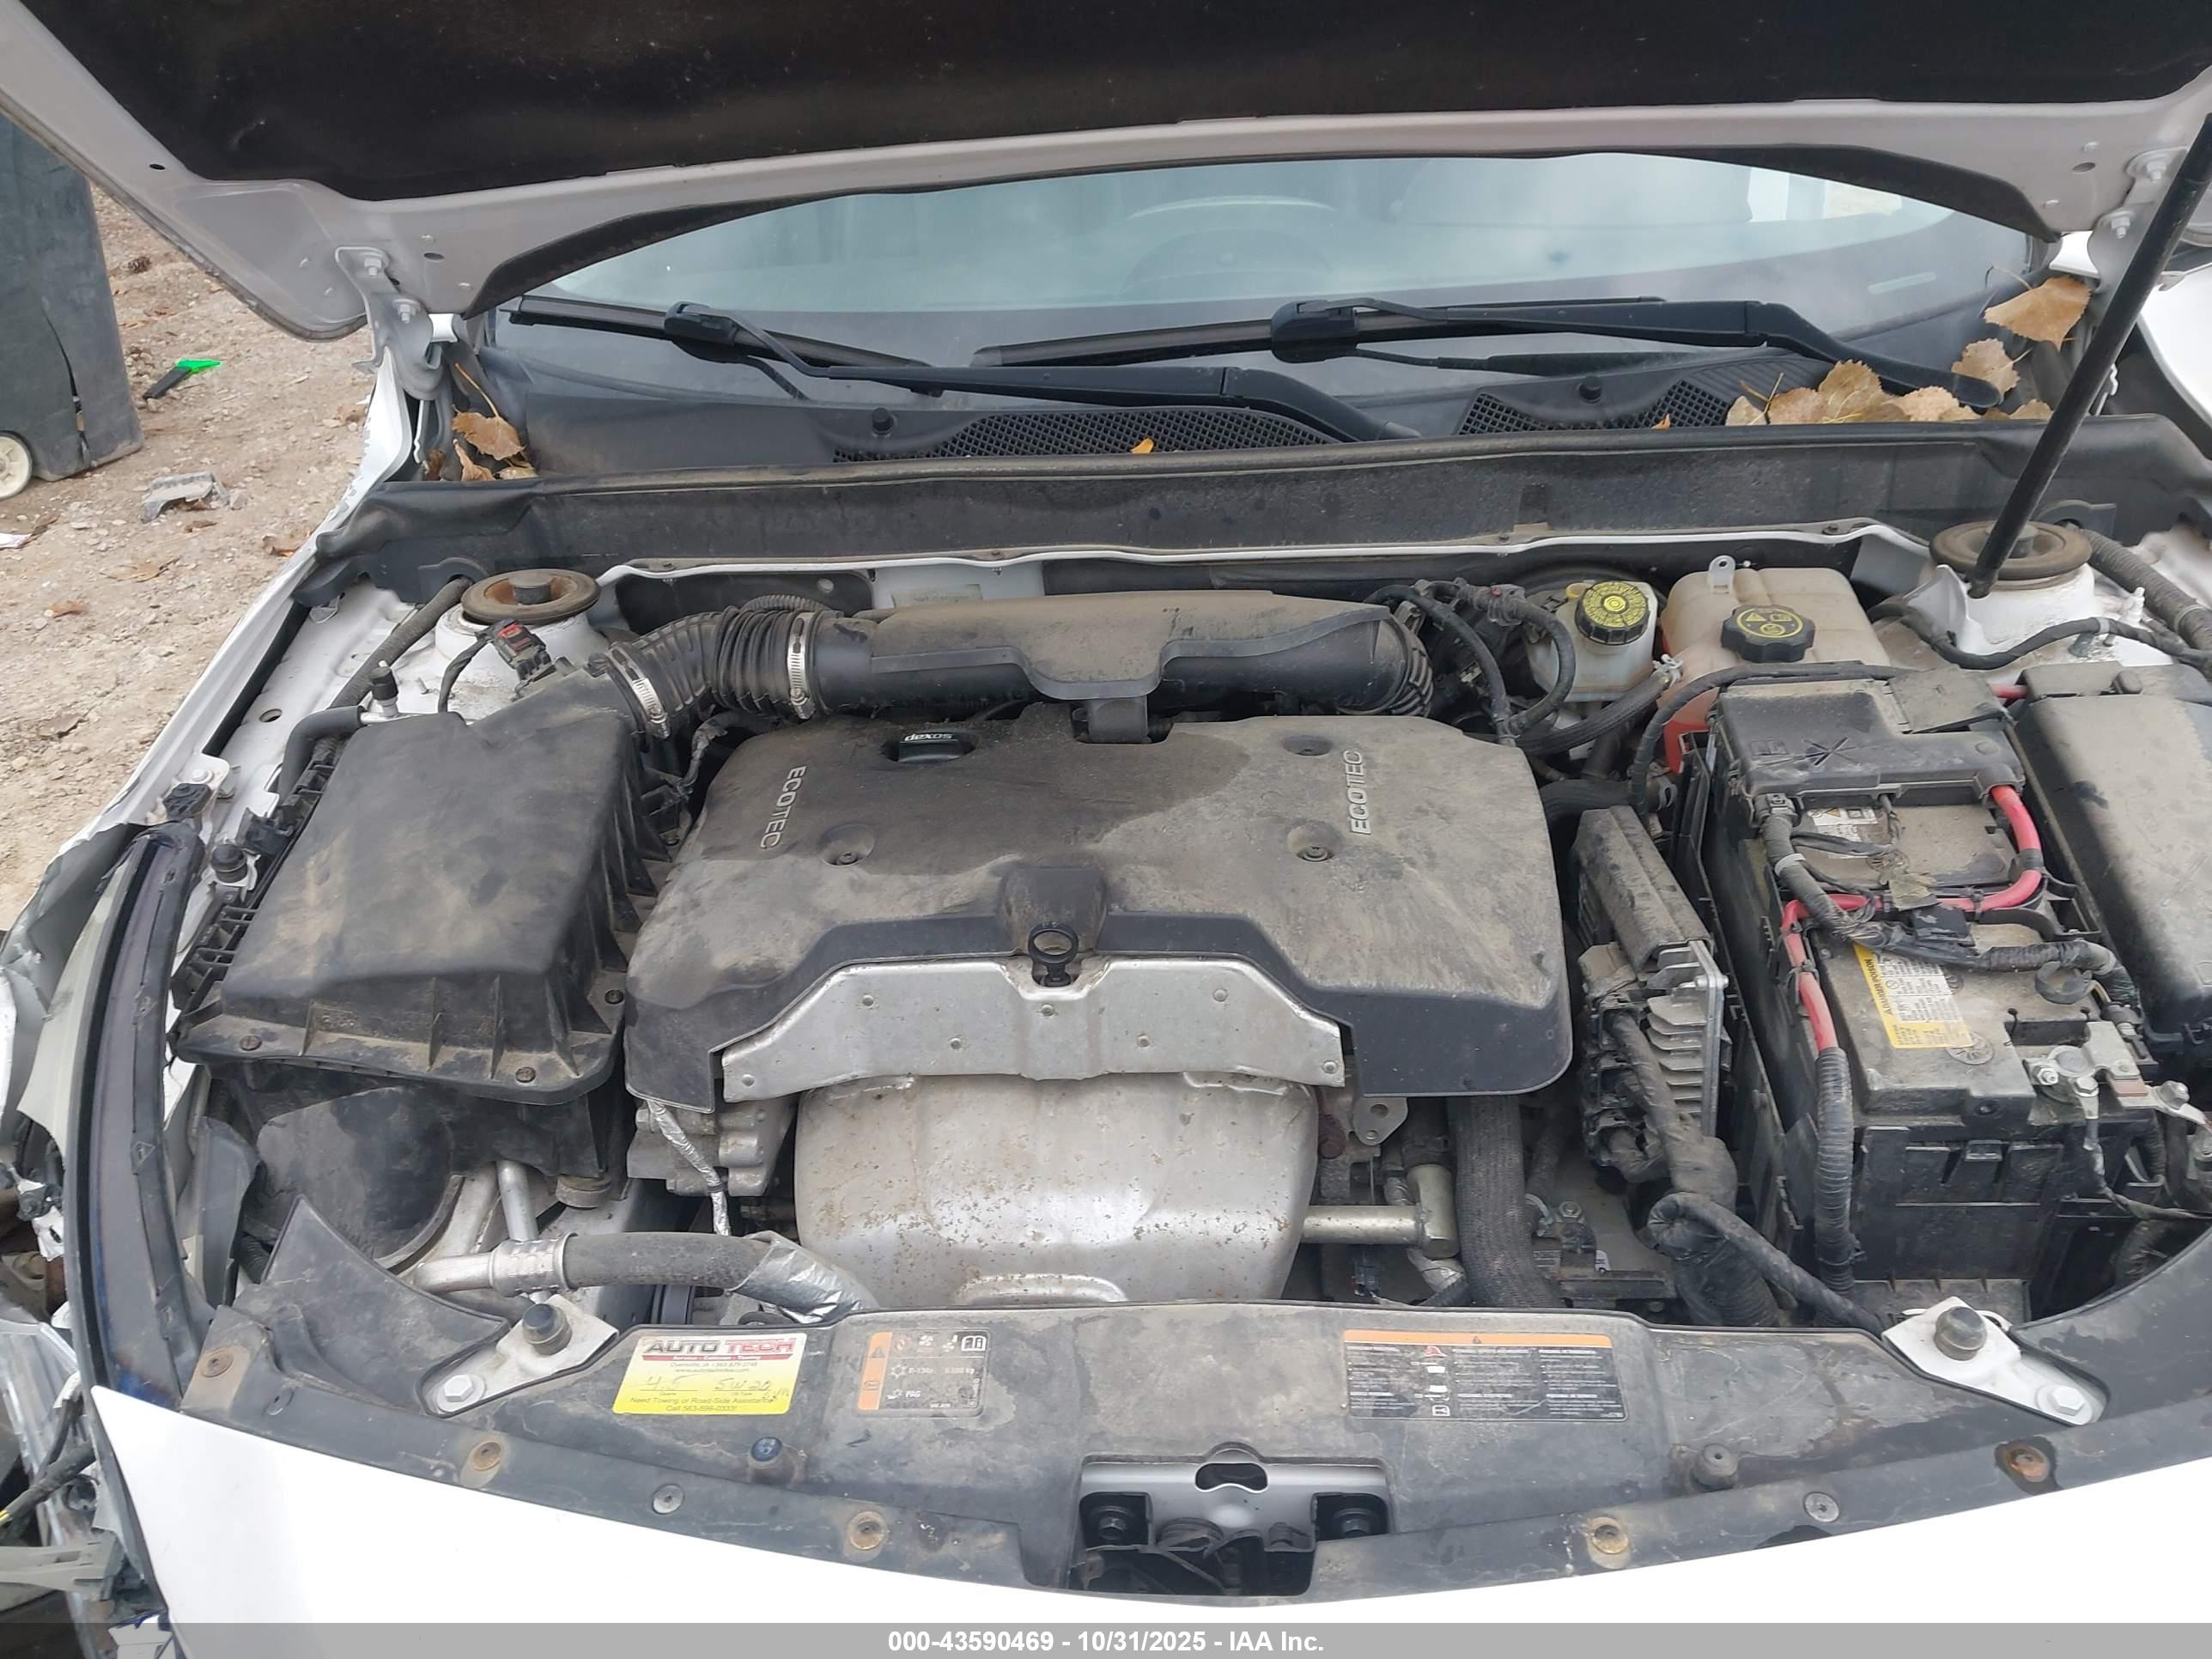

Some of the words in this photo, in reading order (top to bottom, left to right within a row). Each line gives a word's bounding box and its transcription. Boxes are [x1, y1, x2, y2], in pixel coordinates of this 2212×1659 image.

[904, 733, 953, 742] dexos
[761, 765, 806, 849] ECOTEC
[1342, 750, 1371, 835] ECOTEC
[644, 1340, 720, 1353] AUTO
[726, 1338, 797, 1353] TECH
